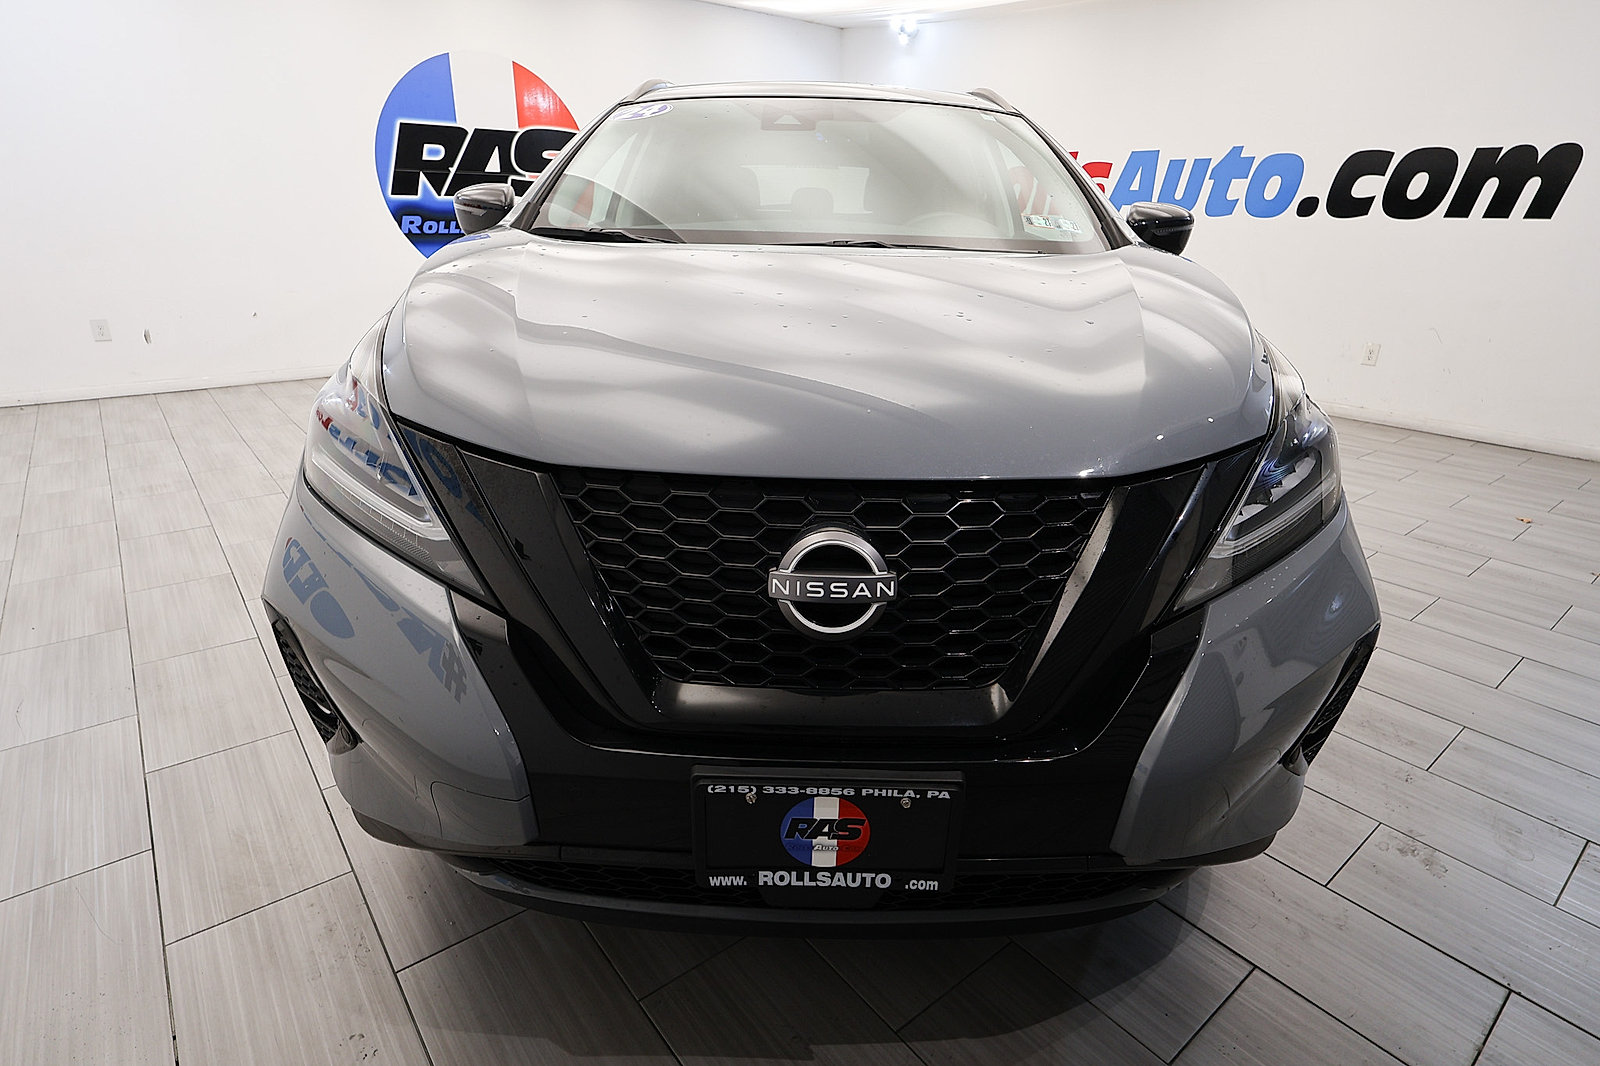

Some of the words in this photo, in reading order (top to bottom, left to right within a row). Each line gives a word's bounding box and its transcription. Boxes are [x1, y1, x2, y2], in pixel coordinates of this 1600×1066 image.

[401, 215, 465, 234] ROLL
[771, 578, 895, 598] NISSAN
[707, 784, 757, 796] (215)
[762, 786, 856, 796] 333-8856
[927, 790, 951, 800] PA
[783, 817, 867, 841] RAS
[708, 875, 748, 886] www.
[757, 870, 892, 889] ROLLSAUTO
[904, 878, 939, 891] .com
